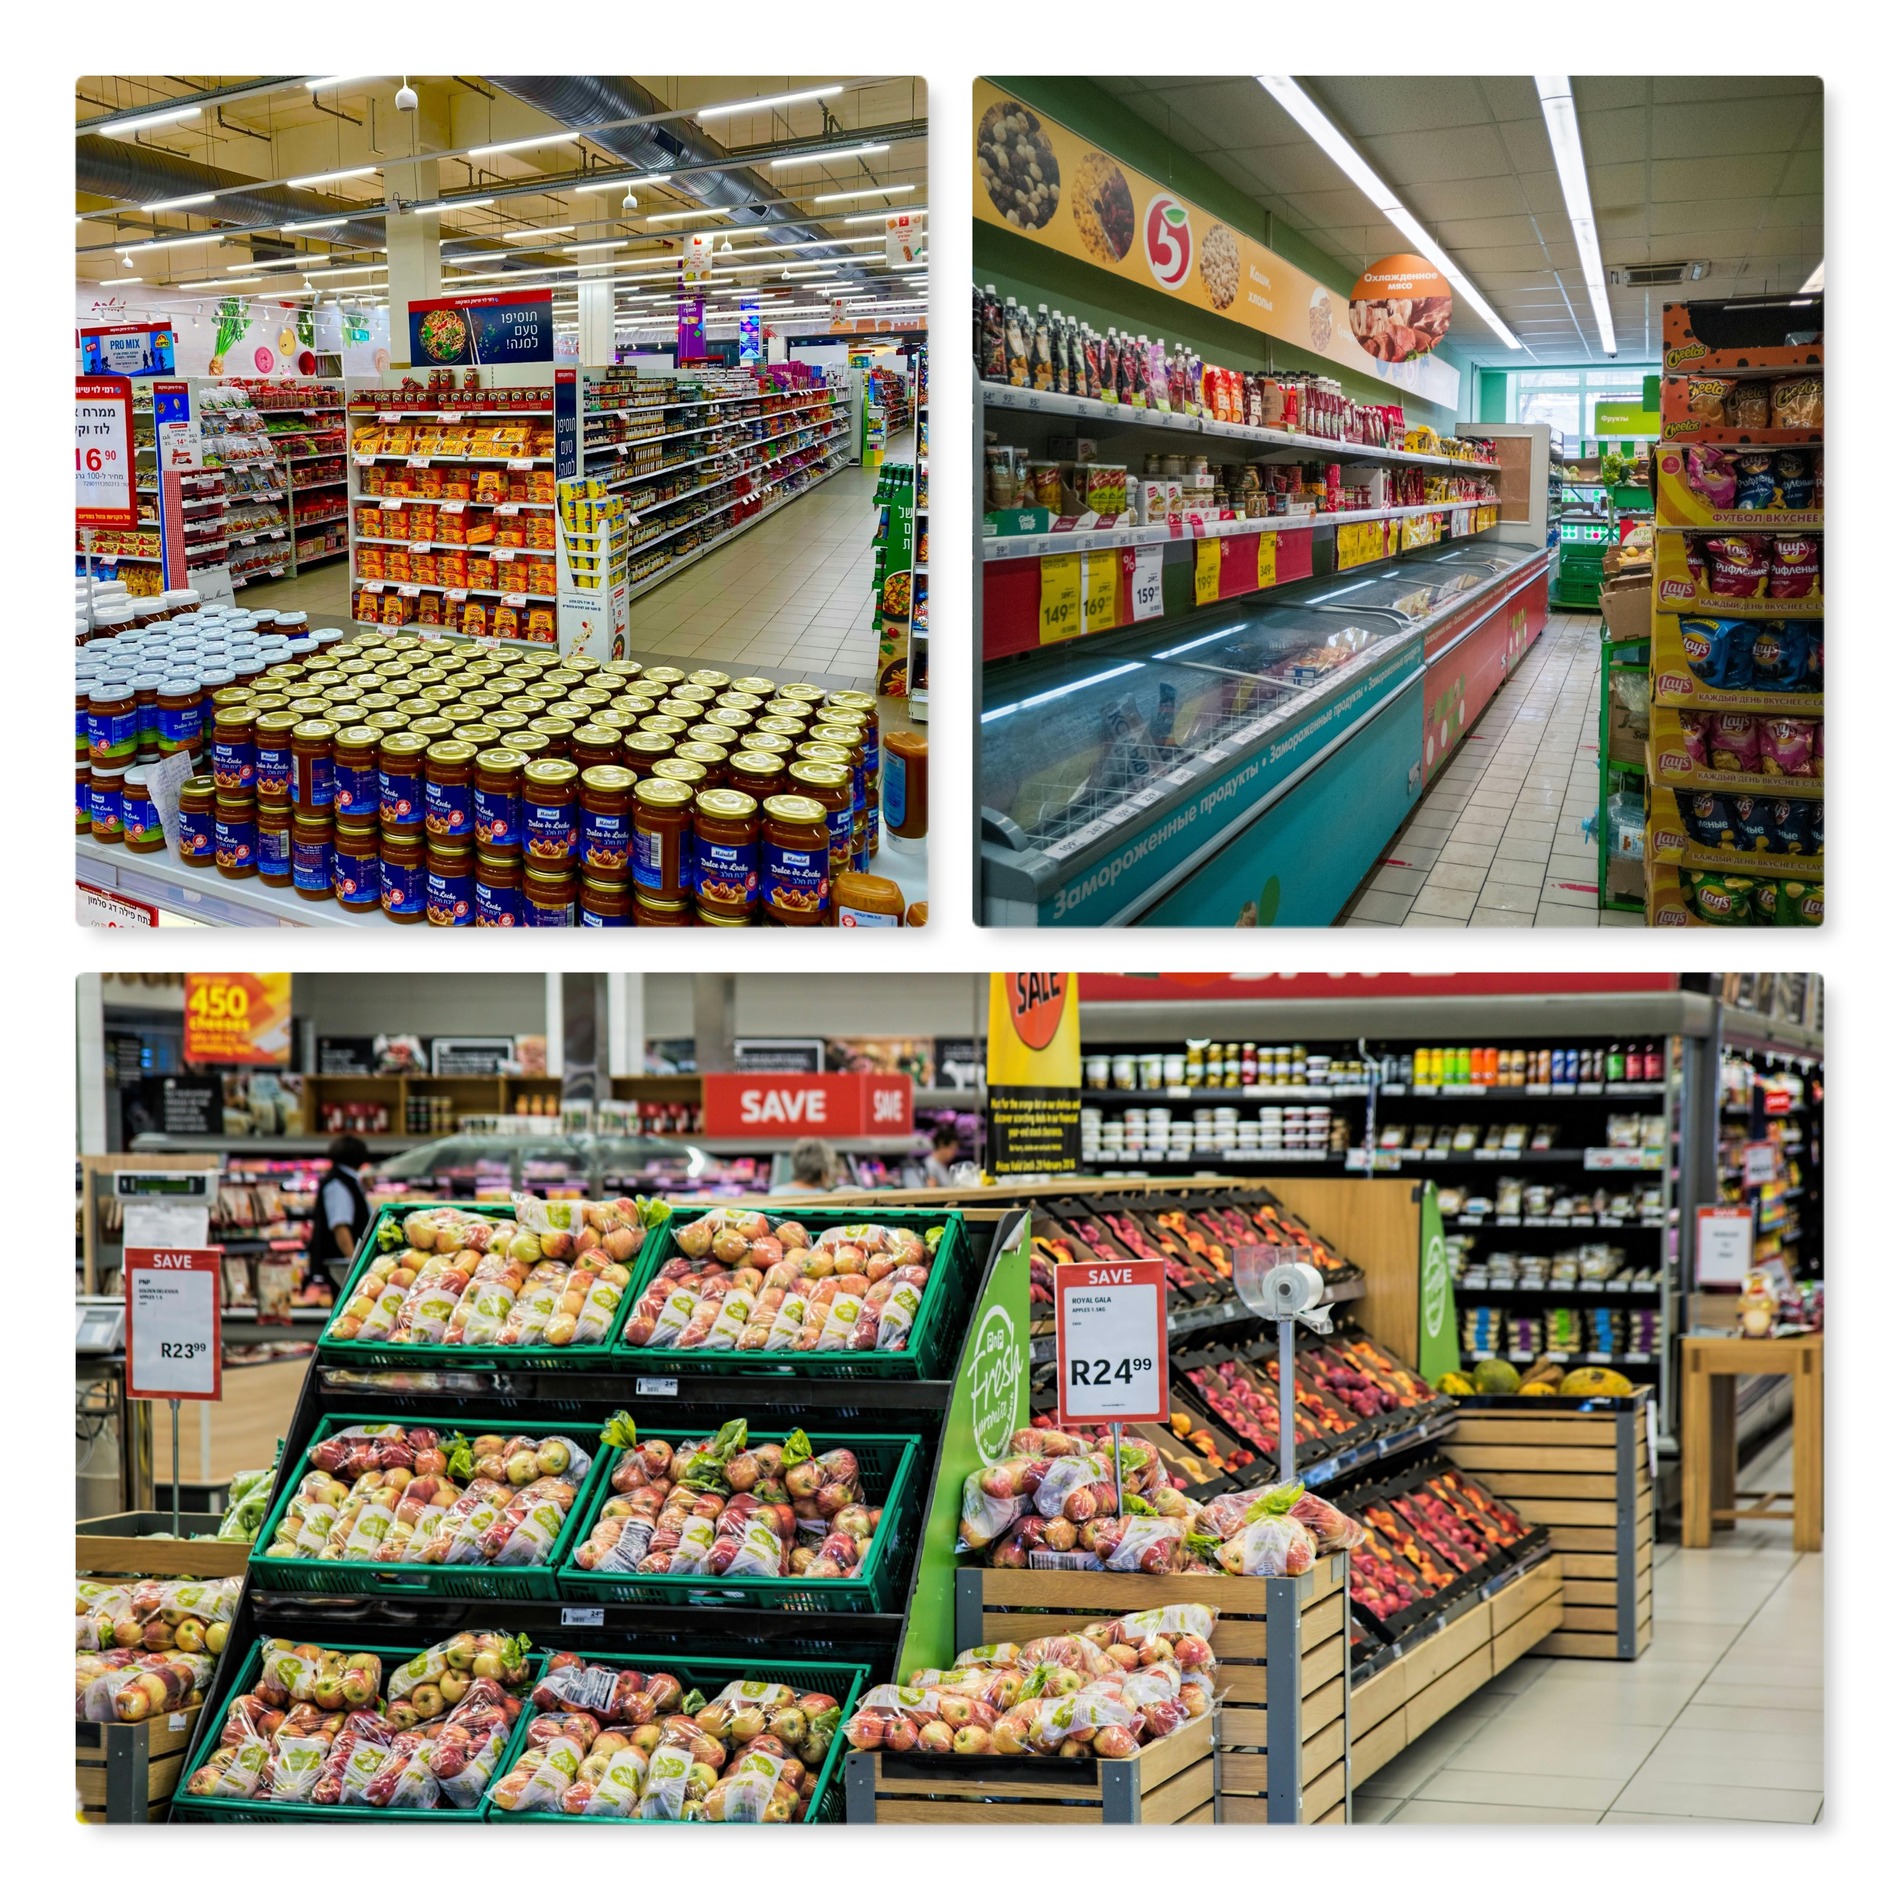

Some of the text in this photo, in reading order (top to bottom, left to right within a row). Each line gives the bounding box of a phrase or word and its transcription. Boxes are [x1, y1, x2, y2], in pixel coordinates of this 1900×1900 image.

[1364, 272, 1438, 283] Охлажденное
[1388, 283, 1413, 291] мясо
[501, 310, 538, 324] תוסיפו
[514, 324, 538, 336] טעם
[110, 338, 140, 350] PRO MIX
[506, 337, 539, 350] למנה!
[1666, 344, 1707, 369] Cheetos
[102, 386, 114, 394] רמי
[1776, 378, 1823, 409] Cheetos
[82, 408, 116, 418] ממרח
[1601, 415, 1629, 423] Фрукты
[97, 423, 110, 434] לוז
[557, 418, 576, 434] תוסיפו
[1664, 420, 1701, 440] Cheetos
[1713, 514, 1819, 523] ФУТБОЛ ВКУСНЕЕ
[1123, 554, 1135, 572] %
[1716, 562, 1768, 576] Рифленые
[1771, 564, 1819, 575] Рифленые
[1700, 600, 1740, 610] КАЖДЫЙ
[1741, 601, 1763, 611] ДЕНЬ
[1765, 602, 1804, 610] ВКУСНЕЕ
[1699, 694, 1738, 703] КАЖДЫЙ
[1740, 694, 1762, 704] ДЕНЬ
[1764, 697, 1802, 706] ВКУСНЕЕ
[1270, 685, 1364, 764] Замороженные продукты
[1698, 772, 1737, 783] КАЖДЫЙ
[1738, 774, 1760, 784] ДЕНЬ
[1762, 777, 1800, 786] ВКУСНЕЕ
[528, 819, 545, 829] Dulce
[553, 819, 571, 829] Leche
[586, 828, 603, 838] Dulce
[612, 830, 630, 840] Leche
[1053, 758, 1259, 920] Замороженные продукты
[700, 858, 720, 869] Dulce
[729, 863, 749, 872] Leche
[1694, 854, 1732, 864] КАЖДЫЙ
[1734, 857, 1756, 866] ДЕНЬ
[1758, 859, 1798, 869] ВКУСНЕЕ
[771, 864, 791, 875] Dulce
[802, 869, 821, 878] Leche
[88, 895, 136, 920] פילה דג סלמון
[1017, 972, 1061, 1015] SALE
[189, 986, 249, 1018] 450
[189, 1017, 249, 1032] cheeses
[741, 1090, 827, 1123] SAVE
[874, 1089, 903, 1122] SAVE
[153, 1254, 192, 1269] SAVE
[1088, 1269, 1133, 1285] SAVE
[1072, 1297, 1094, 1305] ROYAL
[967, 1322, 1024, 1411] Fresh
